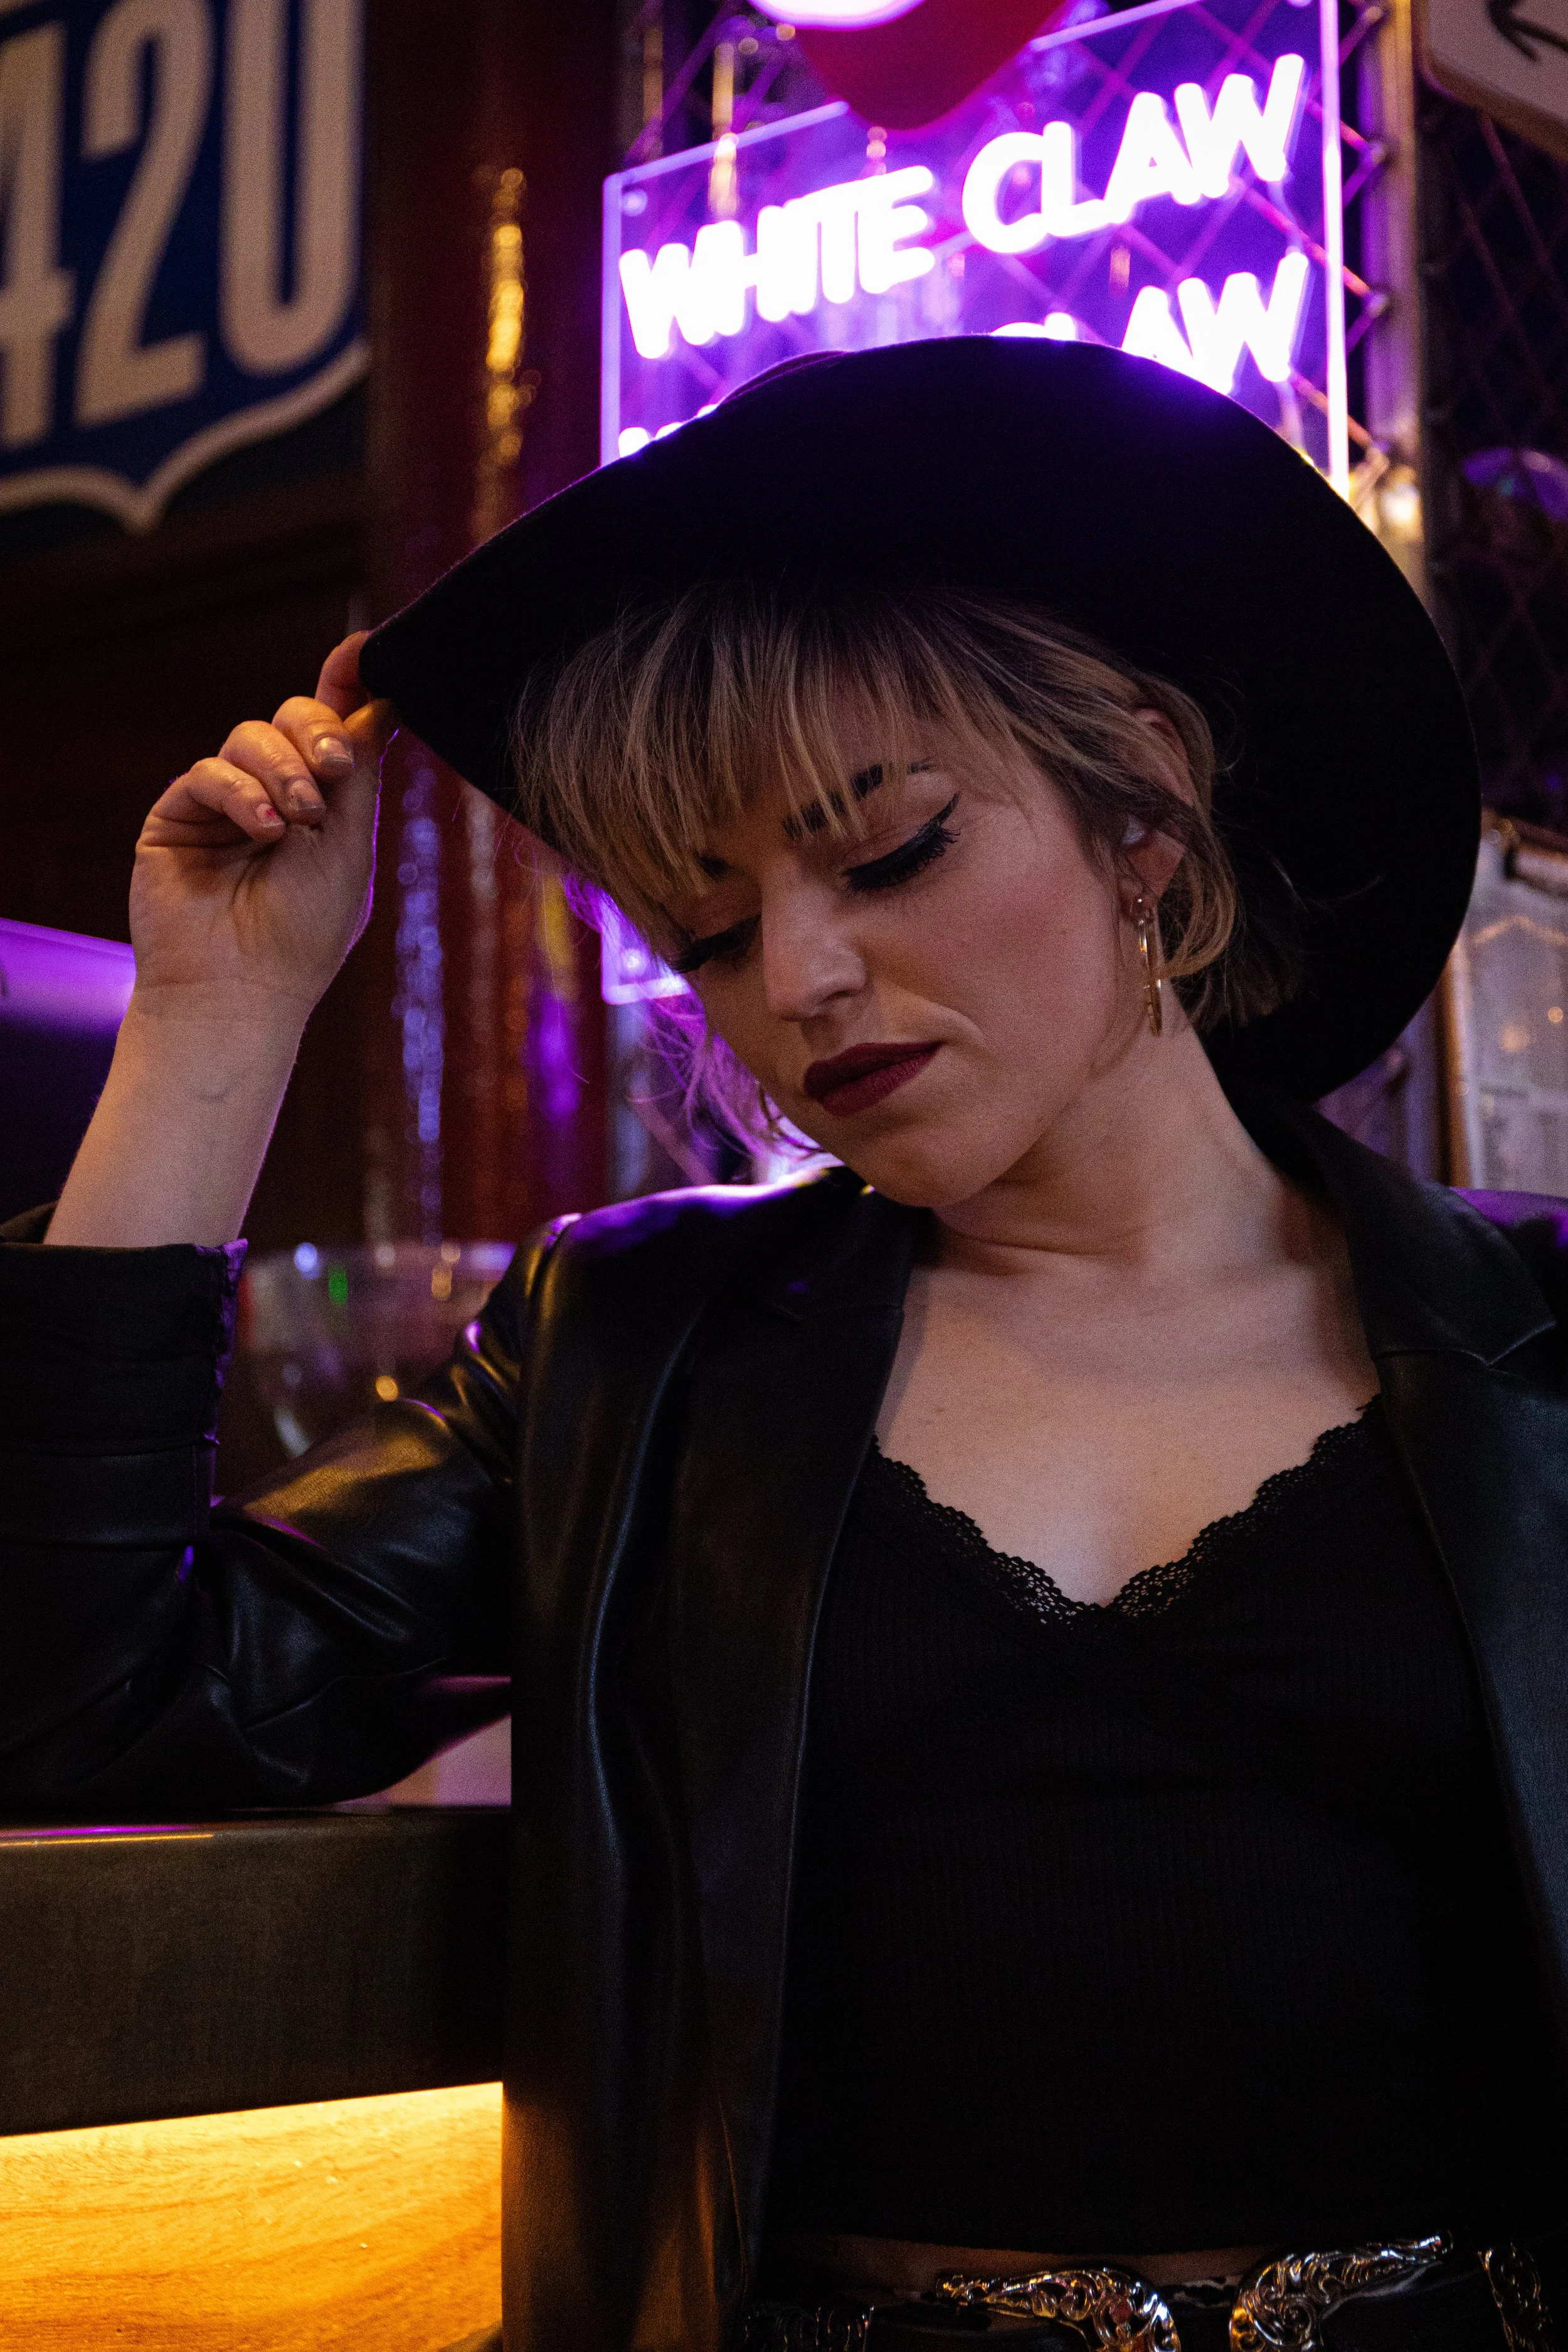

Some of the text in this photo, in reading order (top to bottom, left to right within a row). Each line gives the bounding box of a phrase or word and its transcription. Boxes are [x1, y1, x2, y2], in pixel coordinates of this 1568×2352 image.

[618, 53, 1305, 359] WHITE CLAW
[990, 252, 1309, 396] AW
